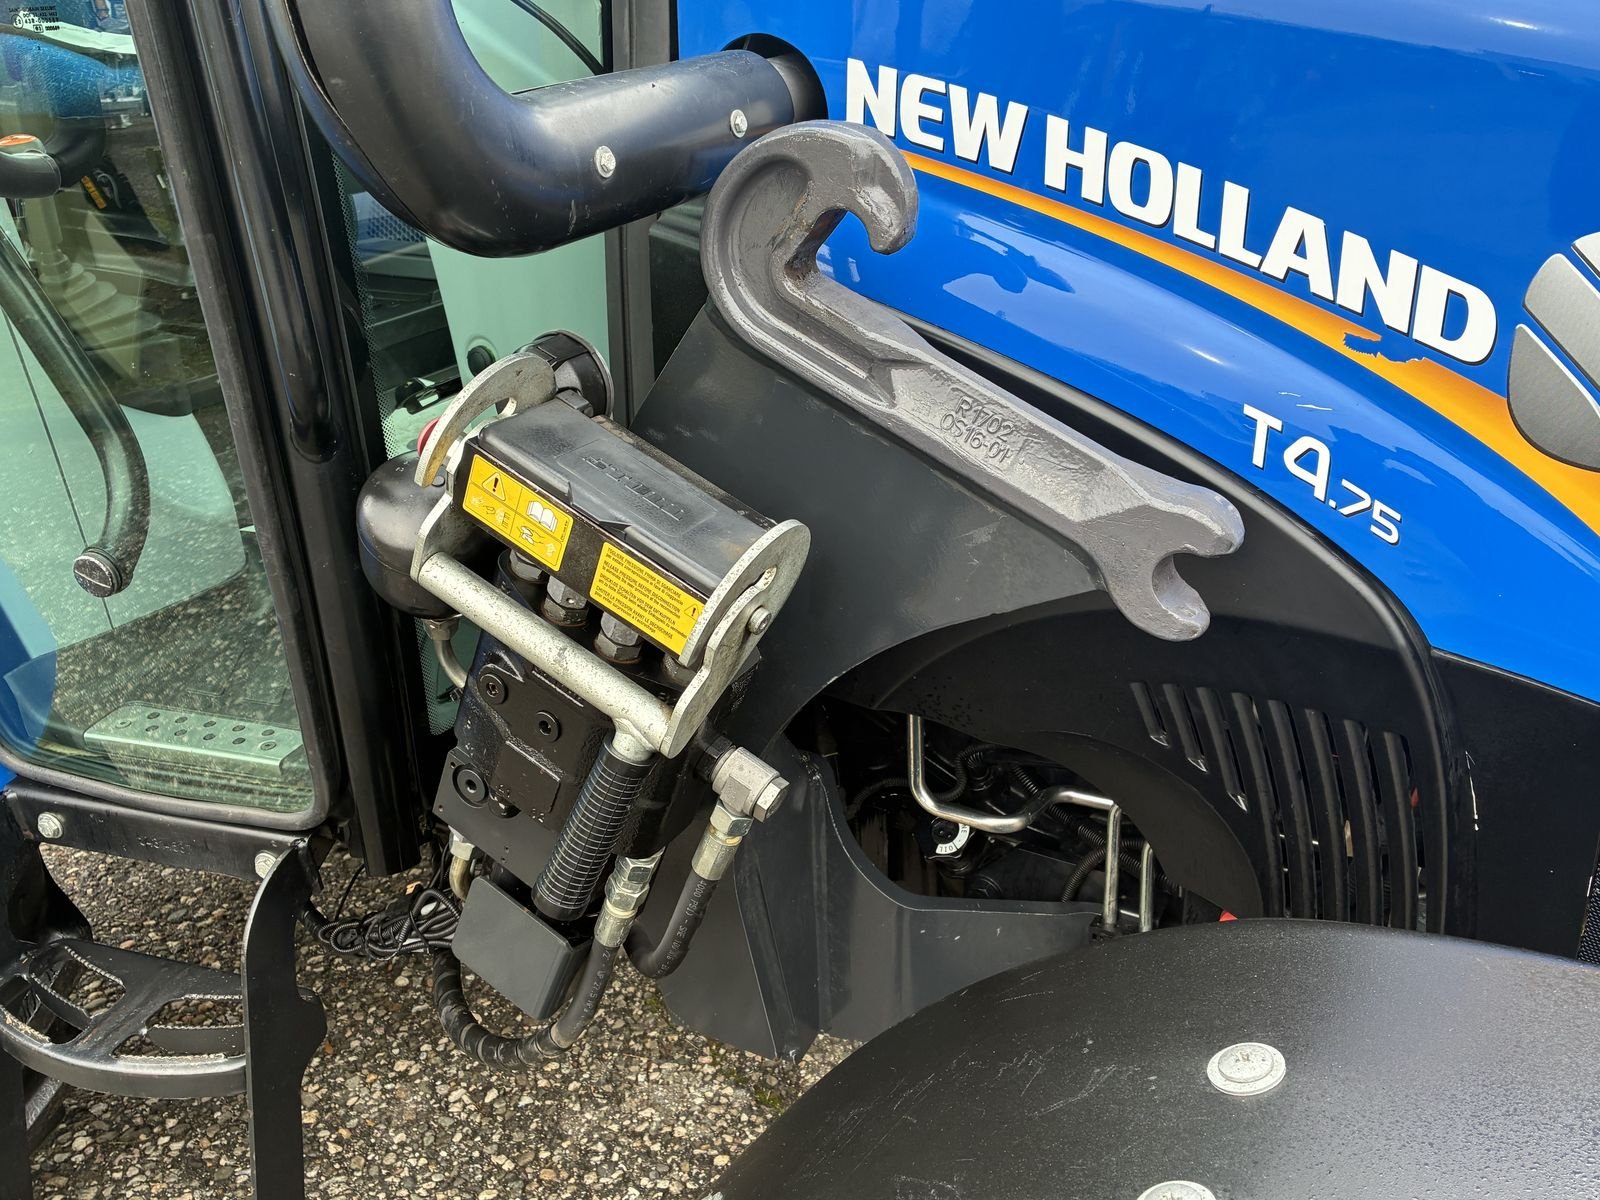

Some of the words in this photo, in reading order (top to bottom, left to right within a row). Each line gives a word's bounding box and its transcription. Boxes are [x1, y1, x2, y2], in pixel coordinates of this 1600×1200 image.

[846, 57, 1029, 175] NEW
[1044, 113, 1498, 365] HOLLAND
[955, 396, 1014, 442] R1702
